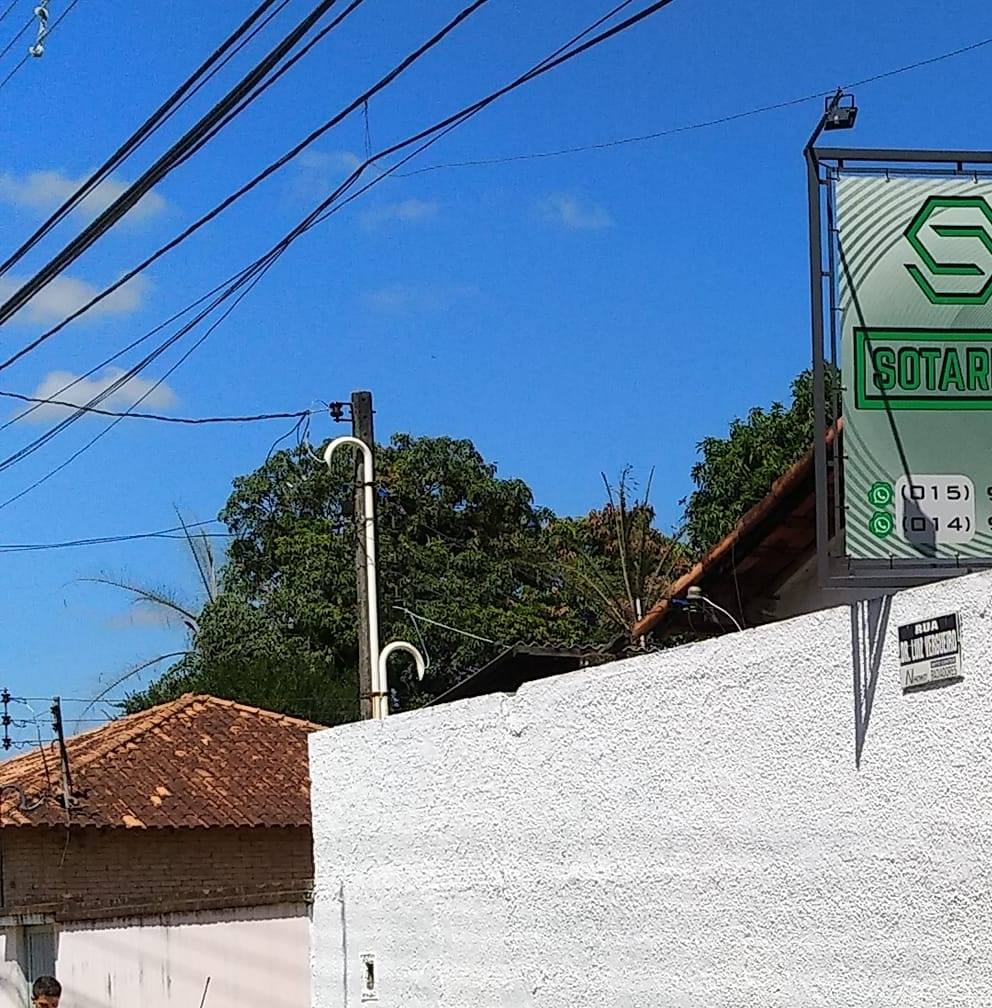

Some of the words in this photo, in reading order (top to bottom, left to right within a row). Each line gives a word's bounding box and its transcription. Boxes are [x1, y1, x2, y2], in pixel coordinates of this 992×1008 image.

[901, 484, 970, 500] (015)
[902, 517, 971, 532] (014)
[914, 620, 939, 635] RUA
